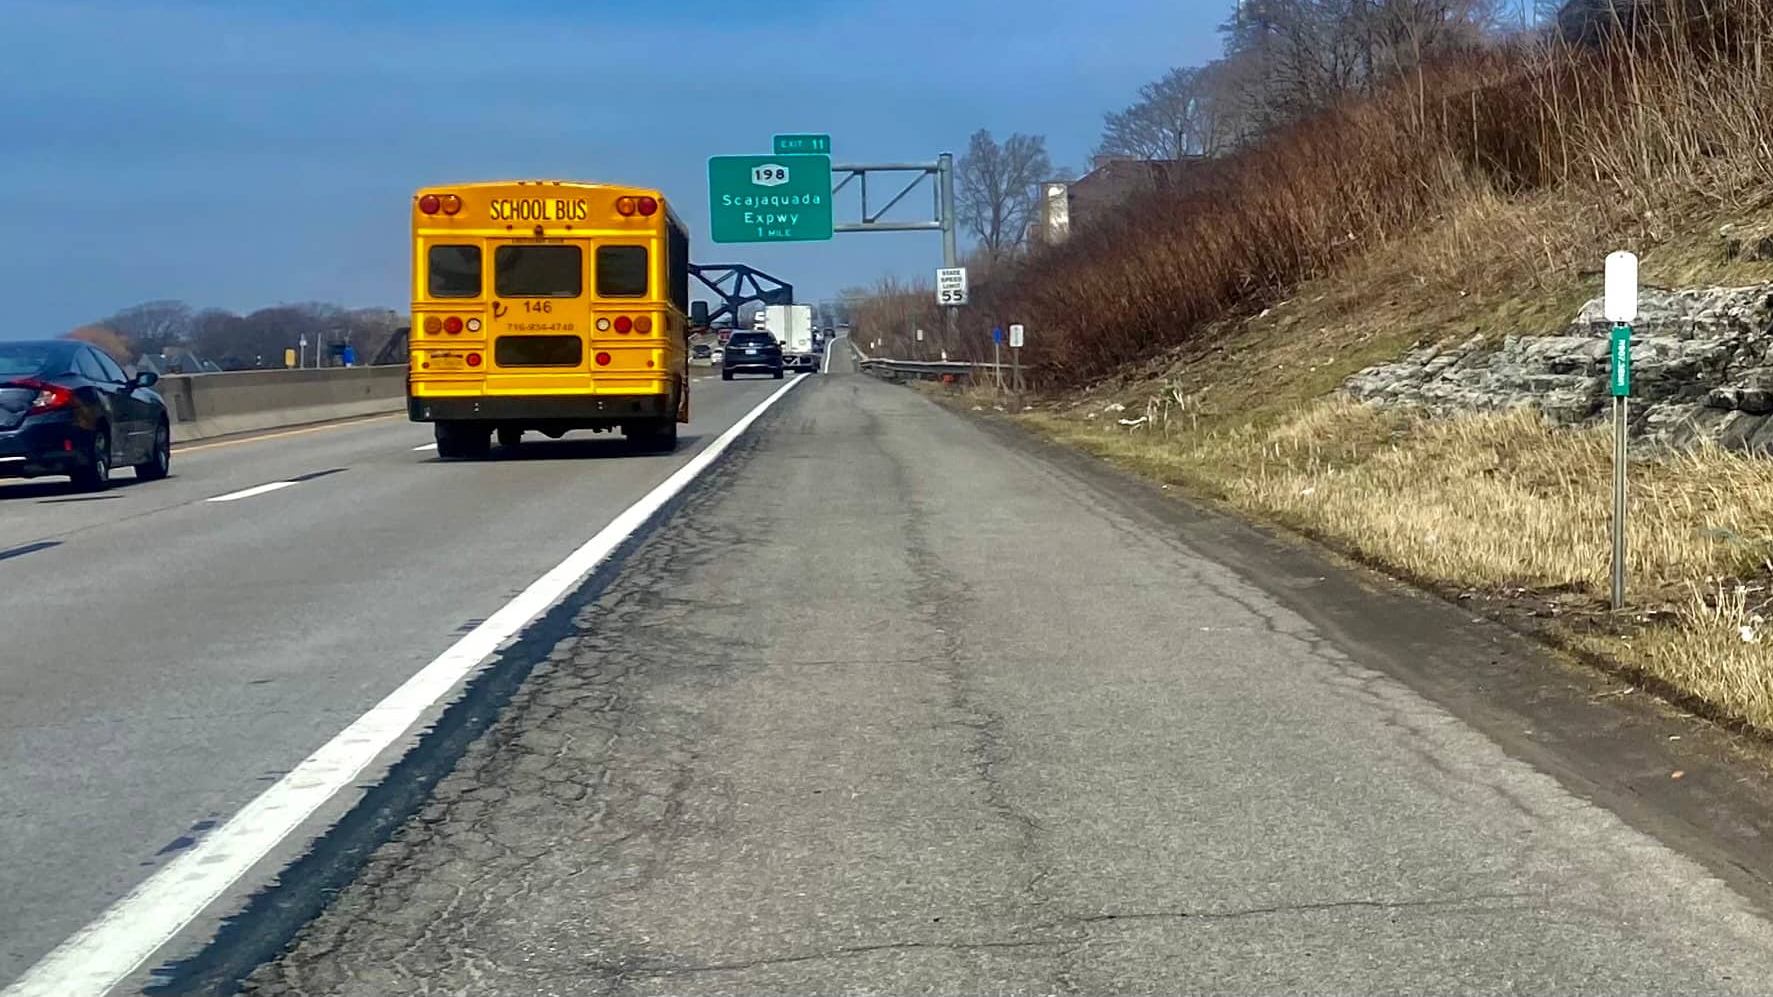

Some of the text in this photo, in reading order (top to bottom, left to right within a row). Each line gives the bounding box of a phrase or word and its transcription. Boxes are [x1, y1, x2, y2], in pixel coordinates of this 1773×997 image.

[812, 138, 825, 150] 11
[755, 169, 785, 181] 198
[722, 193, 821, 208] Scajaquada
[490, 199, 587, 220] SCHOOL BUS
[744, 212, 799, 225] Expwy
[757, 227, 792, 238] 1 MILE
[942, 289, 963, 302] 55
[523, 300, 553, 314] 146
